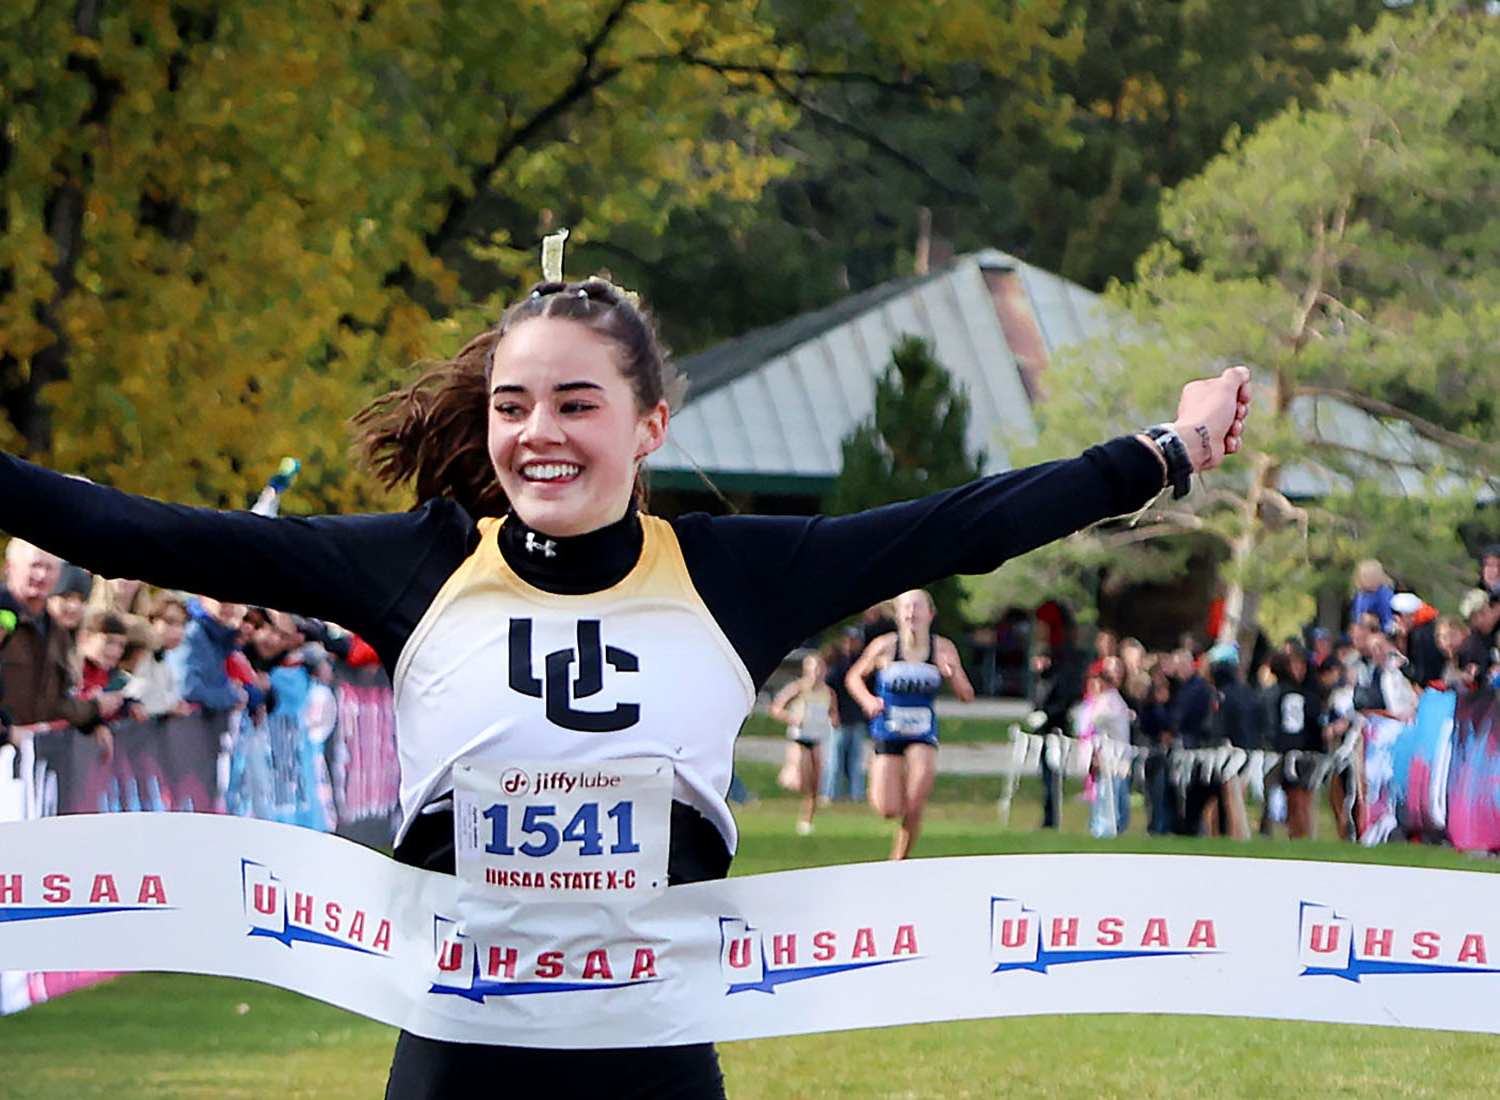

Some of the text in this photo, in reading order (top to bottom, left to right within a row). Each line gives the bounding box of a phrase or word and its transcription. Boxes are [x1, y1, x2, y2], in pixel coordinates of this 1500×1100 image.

[507, 617, 640, 732] UC
[482, 800, 640, 857] 1541
[485, 867, 636, 890] UHSAA STATE X-C
[254, 884, 393, 952] UHSAA
[1001, 918, 1217, 949] UHSAA
[438, 941, 657, 980] UHSAA
[729, 924, 919, 969] UHSAA
